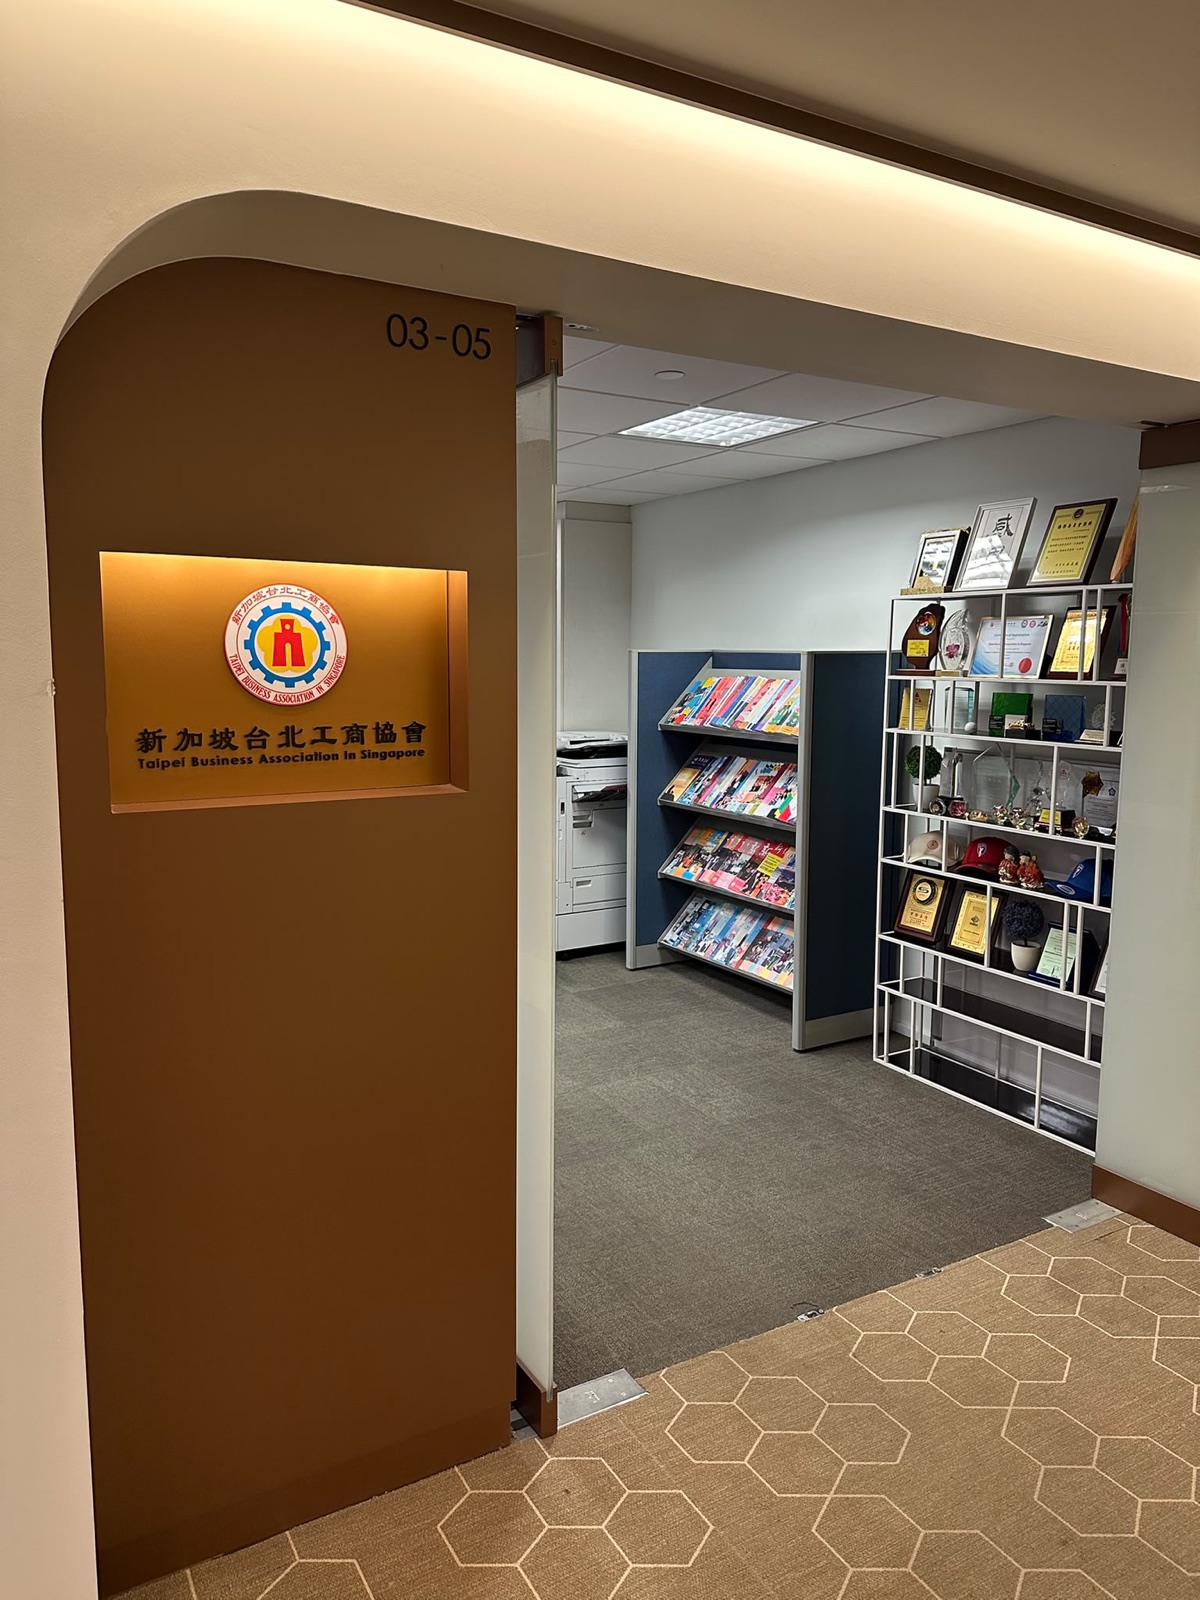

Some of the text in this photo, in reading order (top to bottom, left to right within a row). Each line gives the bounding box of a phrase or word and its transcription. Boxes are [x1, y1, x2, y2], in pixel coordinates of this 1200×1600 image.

[386, 313, 492, 360] 03-05
[231, 586, 340, 626] 新加坡台北工商協會
[229, 653, 345, 704] TAIPEI BUSINESS ASSOCIATION IN SINGAPORE
[135, 720, 427, 754] 新加坡台北工商協會
[138, 748, 426, 771] Taipei Business Association In Singapore
